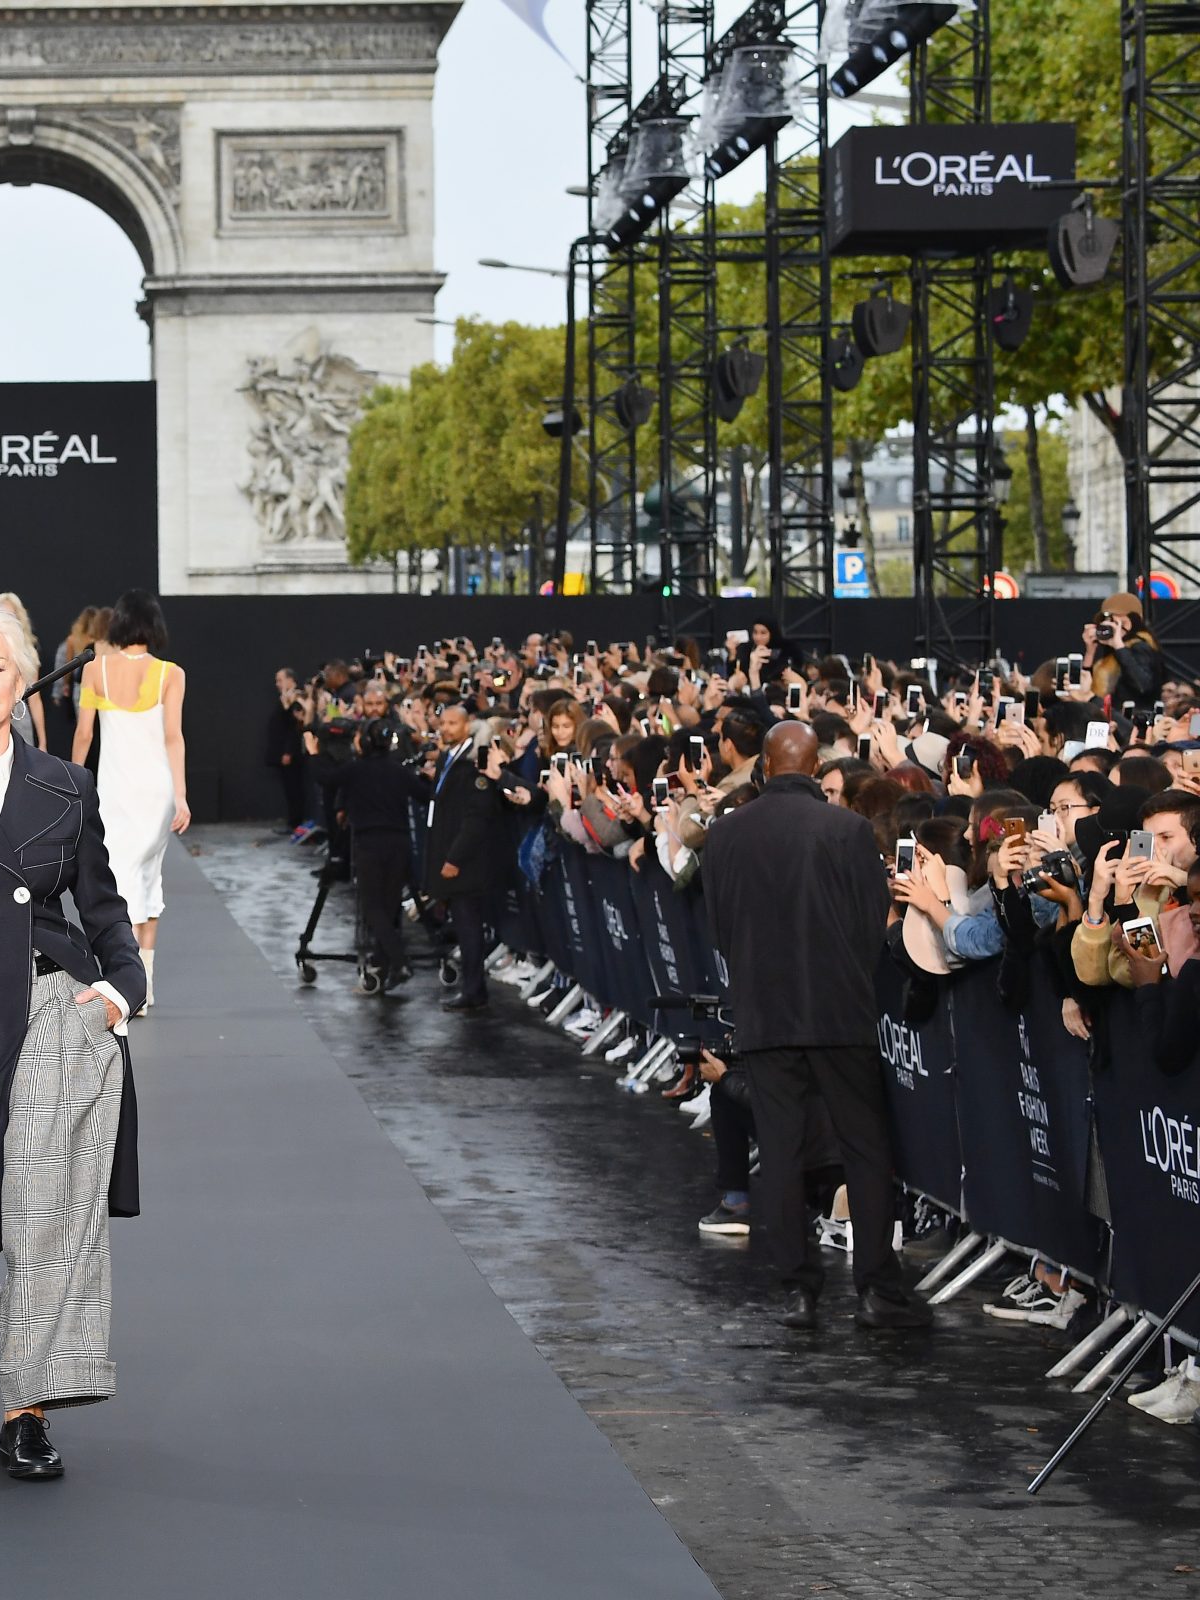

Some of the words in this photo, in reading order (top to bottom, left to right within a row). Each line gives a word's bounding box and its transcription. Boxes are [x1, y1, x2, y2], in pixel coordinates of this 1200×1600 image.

[875, 151, 1051, 187] L'ORÉAL
[876, 1012, 929, 1077] L'ORÉAL
[1139, 1105, 1200, 1179] L'ORÉ
